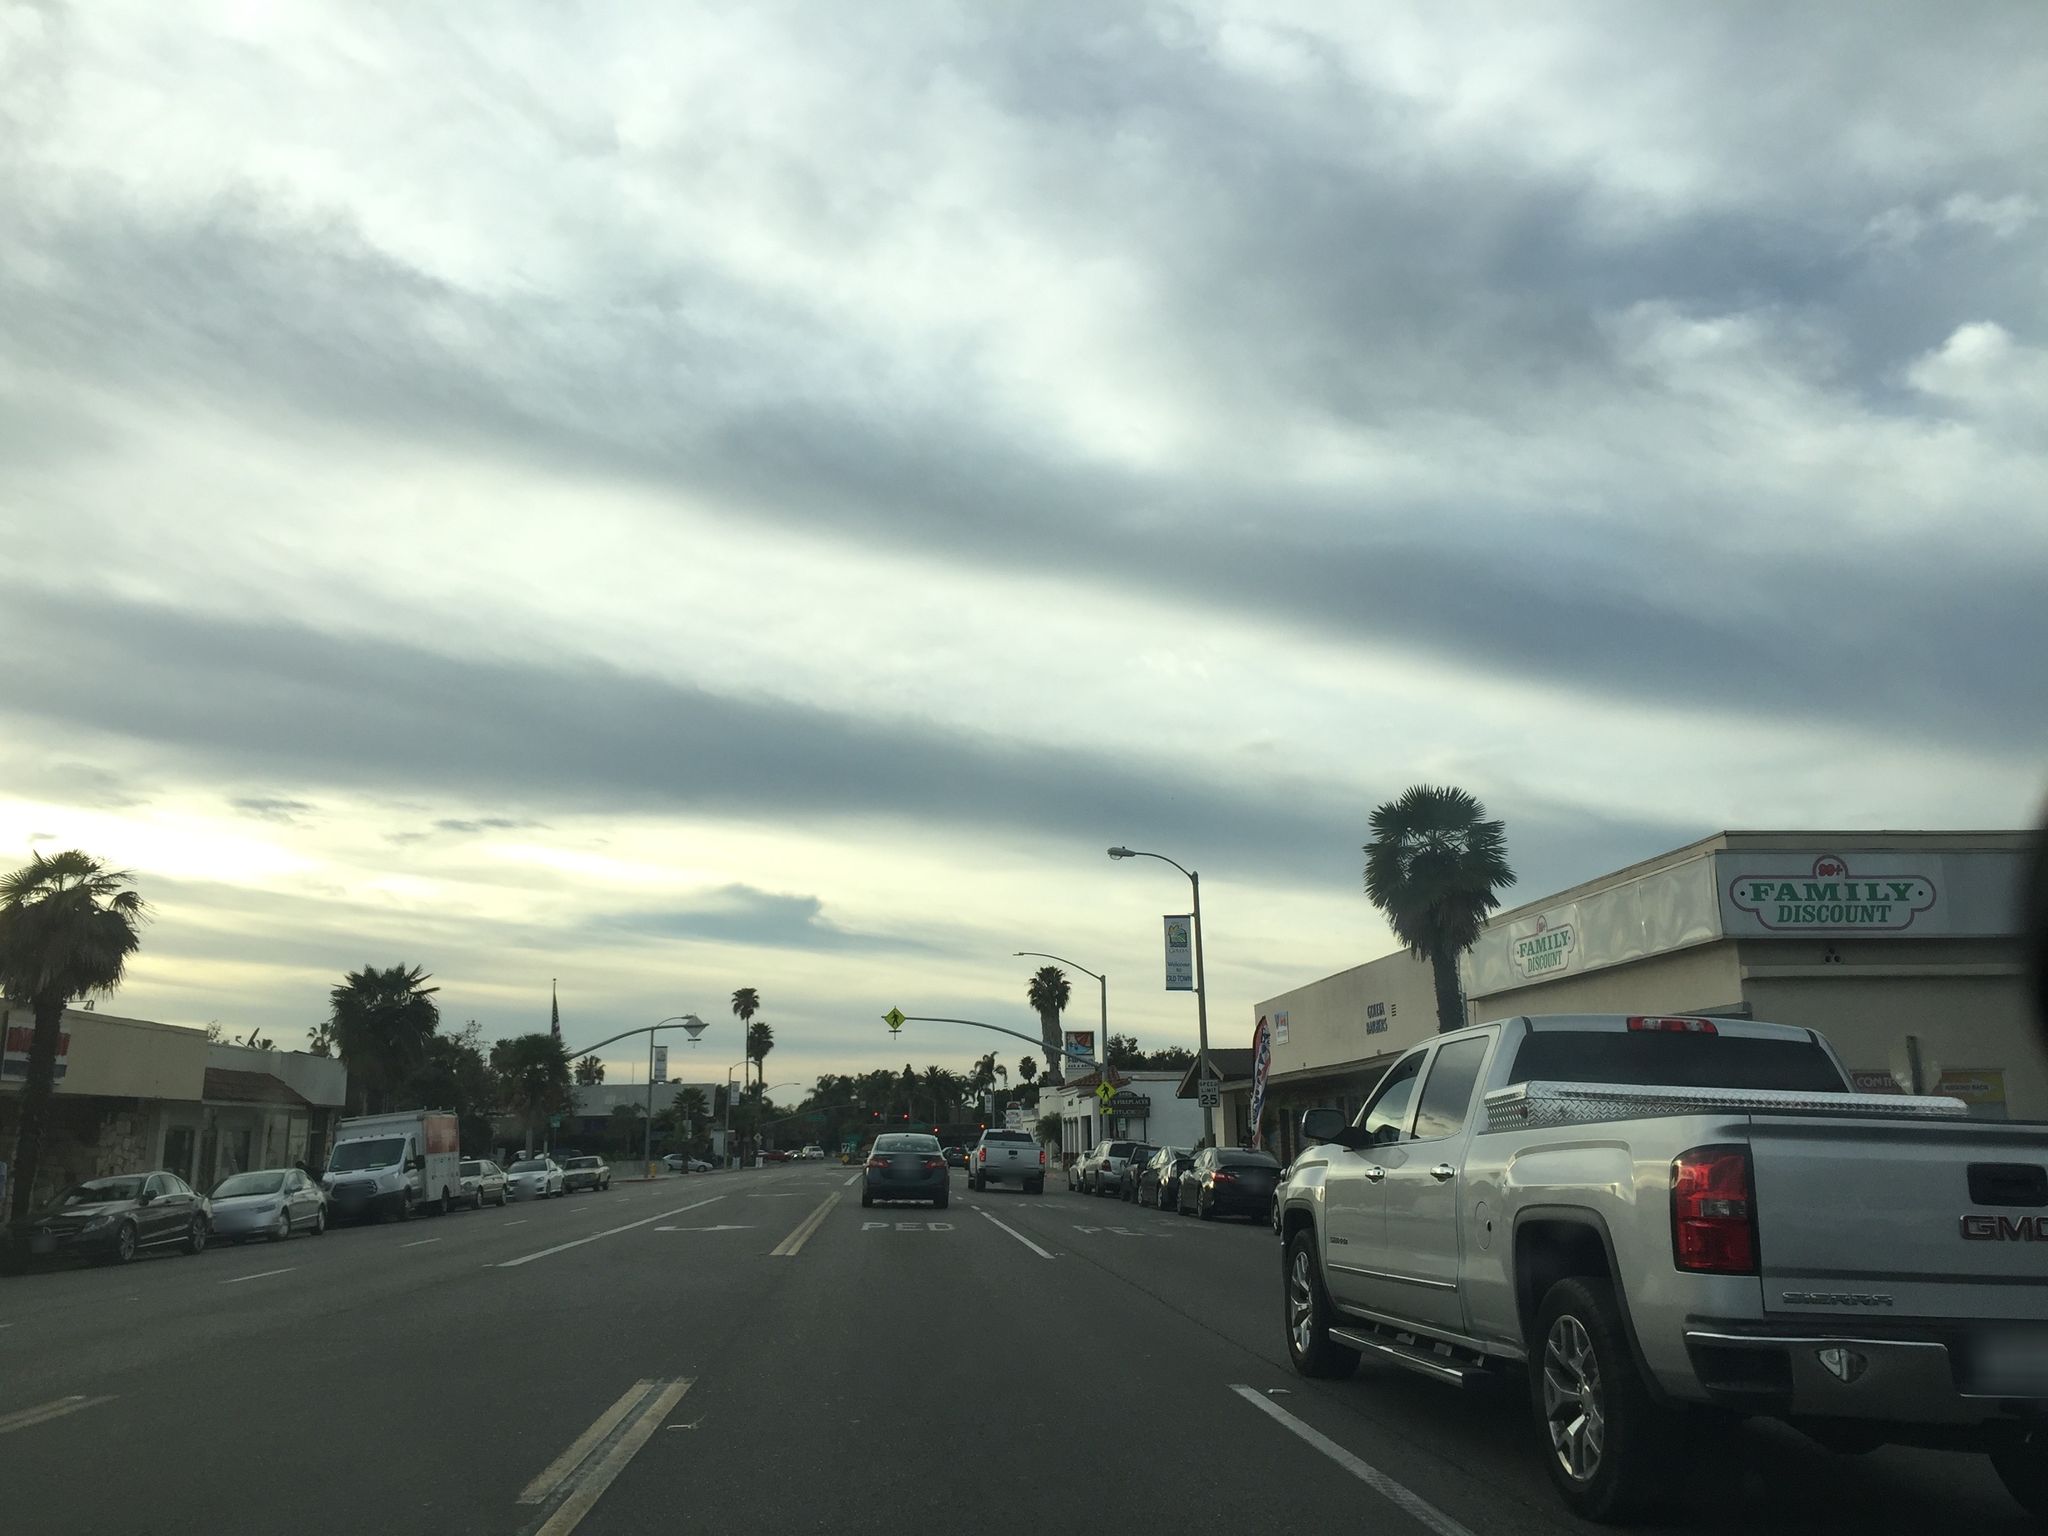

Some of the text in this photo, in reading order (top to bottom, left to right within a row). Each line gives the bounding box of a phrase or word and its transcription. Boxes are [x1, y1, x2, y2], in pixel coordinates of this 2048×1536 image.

[1749, 882, 1914, 902] FAMILY
[1777, 904, 1892, 923] DISCOUNT
[1518, 930, 1569, 958] FAMILY
[1527, 950, 1563, 973] DISCOUNT
[1201, 1094, 1218, 1105] 25
[861, 1221, 956, 1232] PED
[1782, 1291, 1894, 1306] SIERRA
